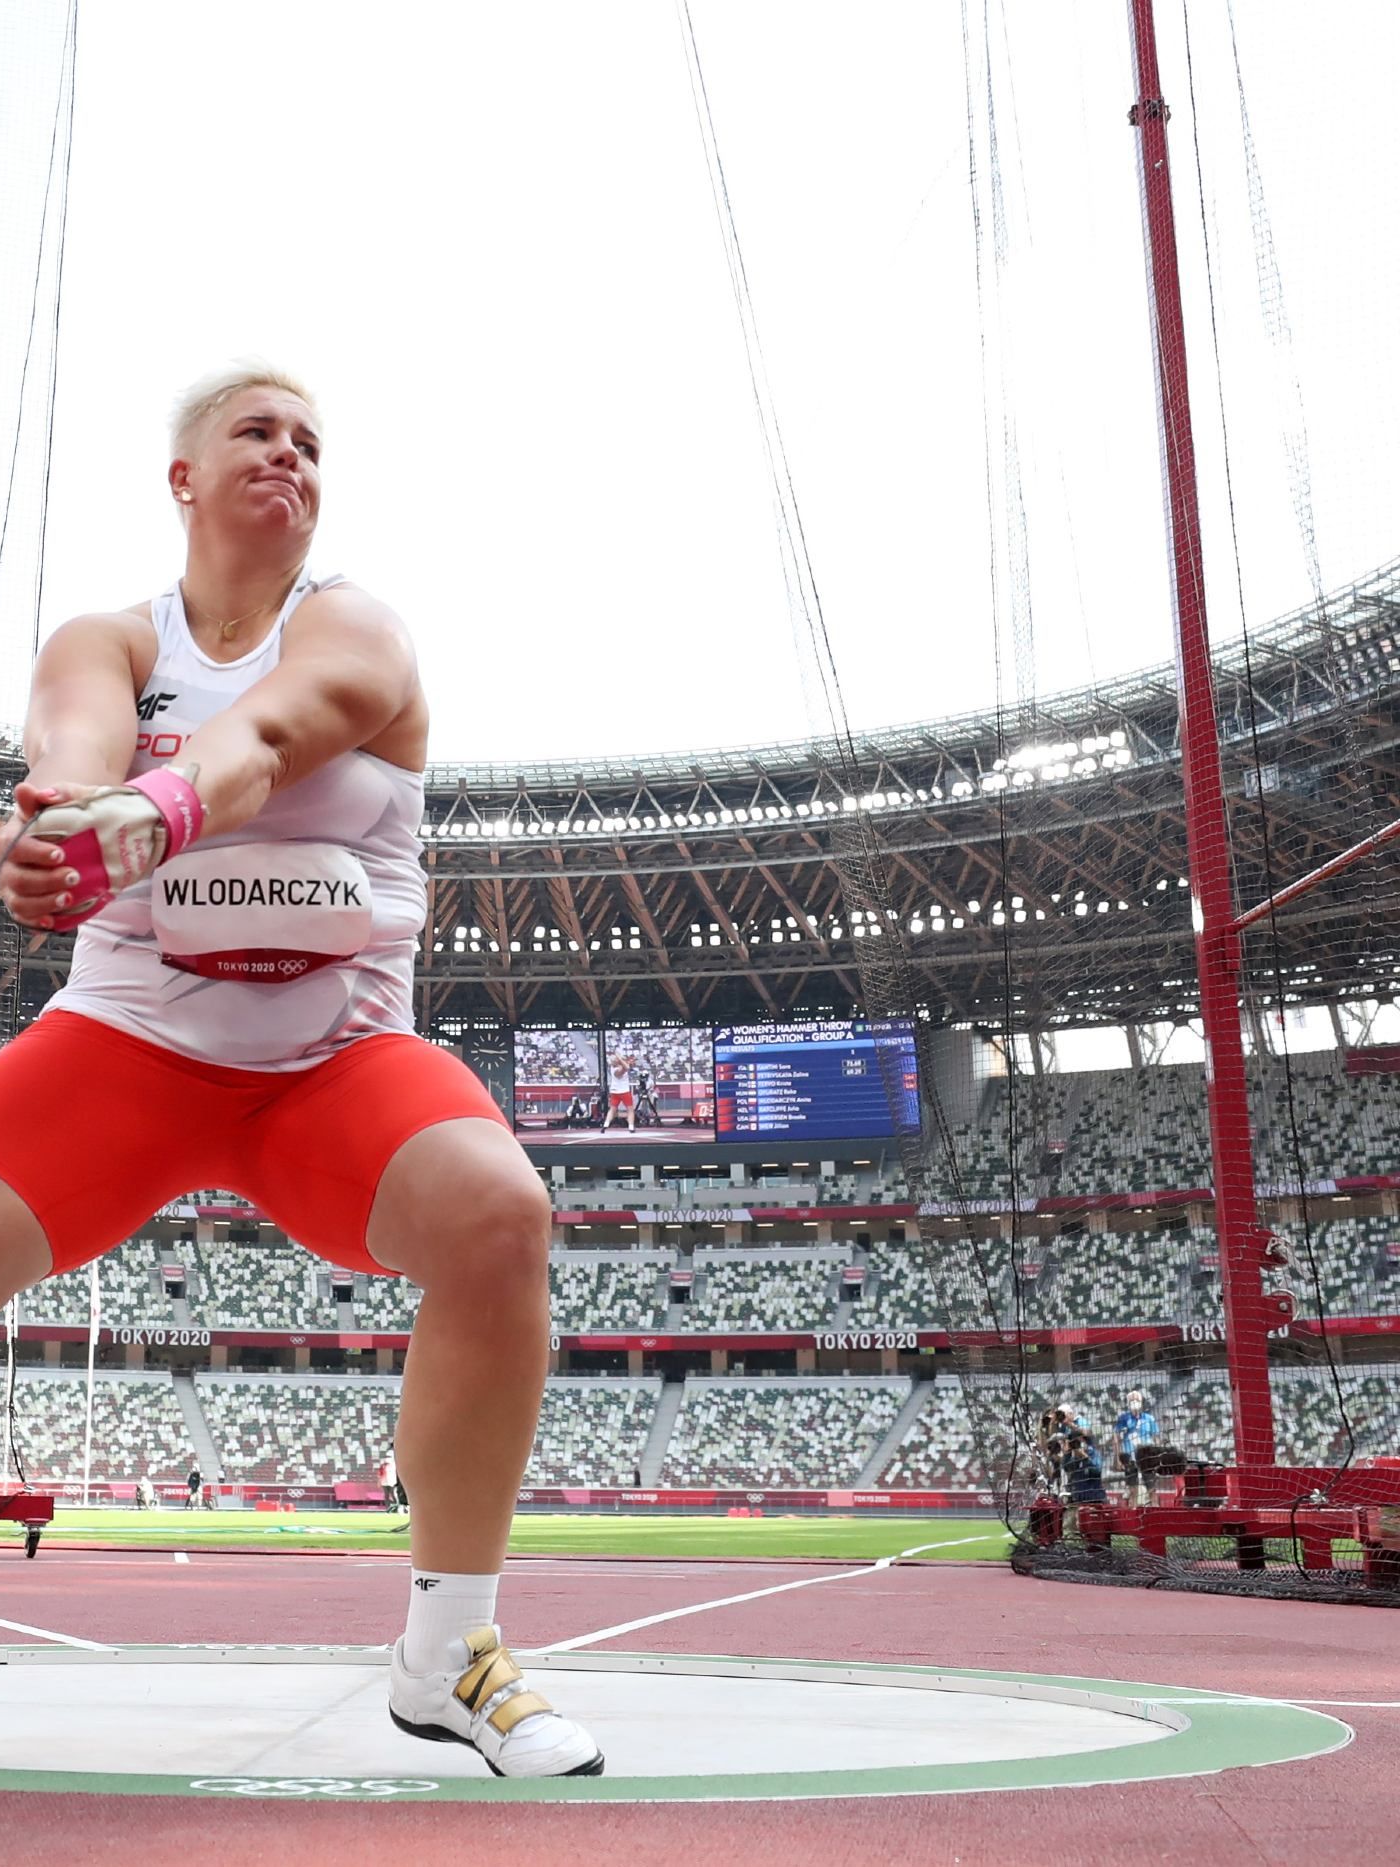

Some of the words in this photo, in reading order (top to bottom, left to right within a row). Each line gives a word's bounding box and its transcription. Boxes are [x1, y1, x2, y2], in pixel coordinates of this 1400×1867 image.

[137, 733, 191, 757] PO
[163, 879, 362, 907] WLODARCZYK
[217, 962, 249, 972] TOKYO
[251, 962, 275, 972] 2020
[732, 1025, 775, 1035] WOMEN'S
[776, 1022, 818, 1033] HAMMER
[819, 1021, 852, 1032] THROW
[732, 1034, 804, 1045] QUALIFICATION
[811, 1032, 845, 1042] GROUP
[846, 1031, 854, 1040] A
[156, 1204, 180, 1218] 020
[654, 1209, 697, 1223] TOKYO
[700, 1209, 733, 1222] 2020
[110, 1329, 166, 1346] TOKYO
[169, 1330, 210, 1346] 2020
[1179, 1322, 1227, 1342] TOKY
[813, 1333, 871, 1350] TOKYO
[874, 1333, 917, 1350] 2020
